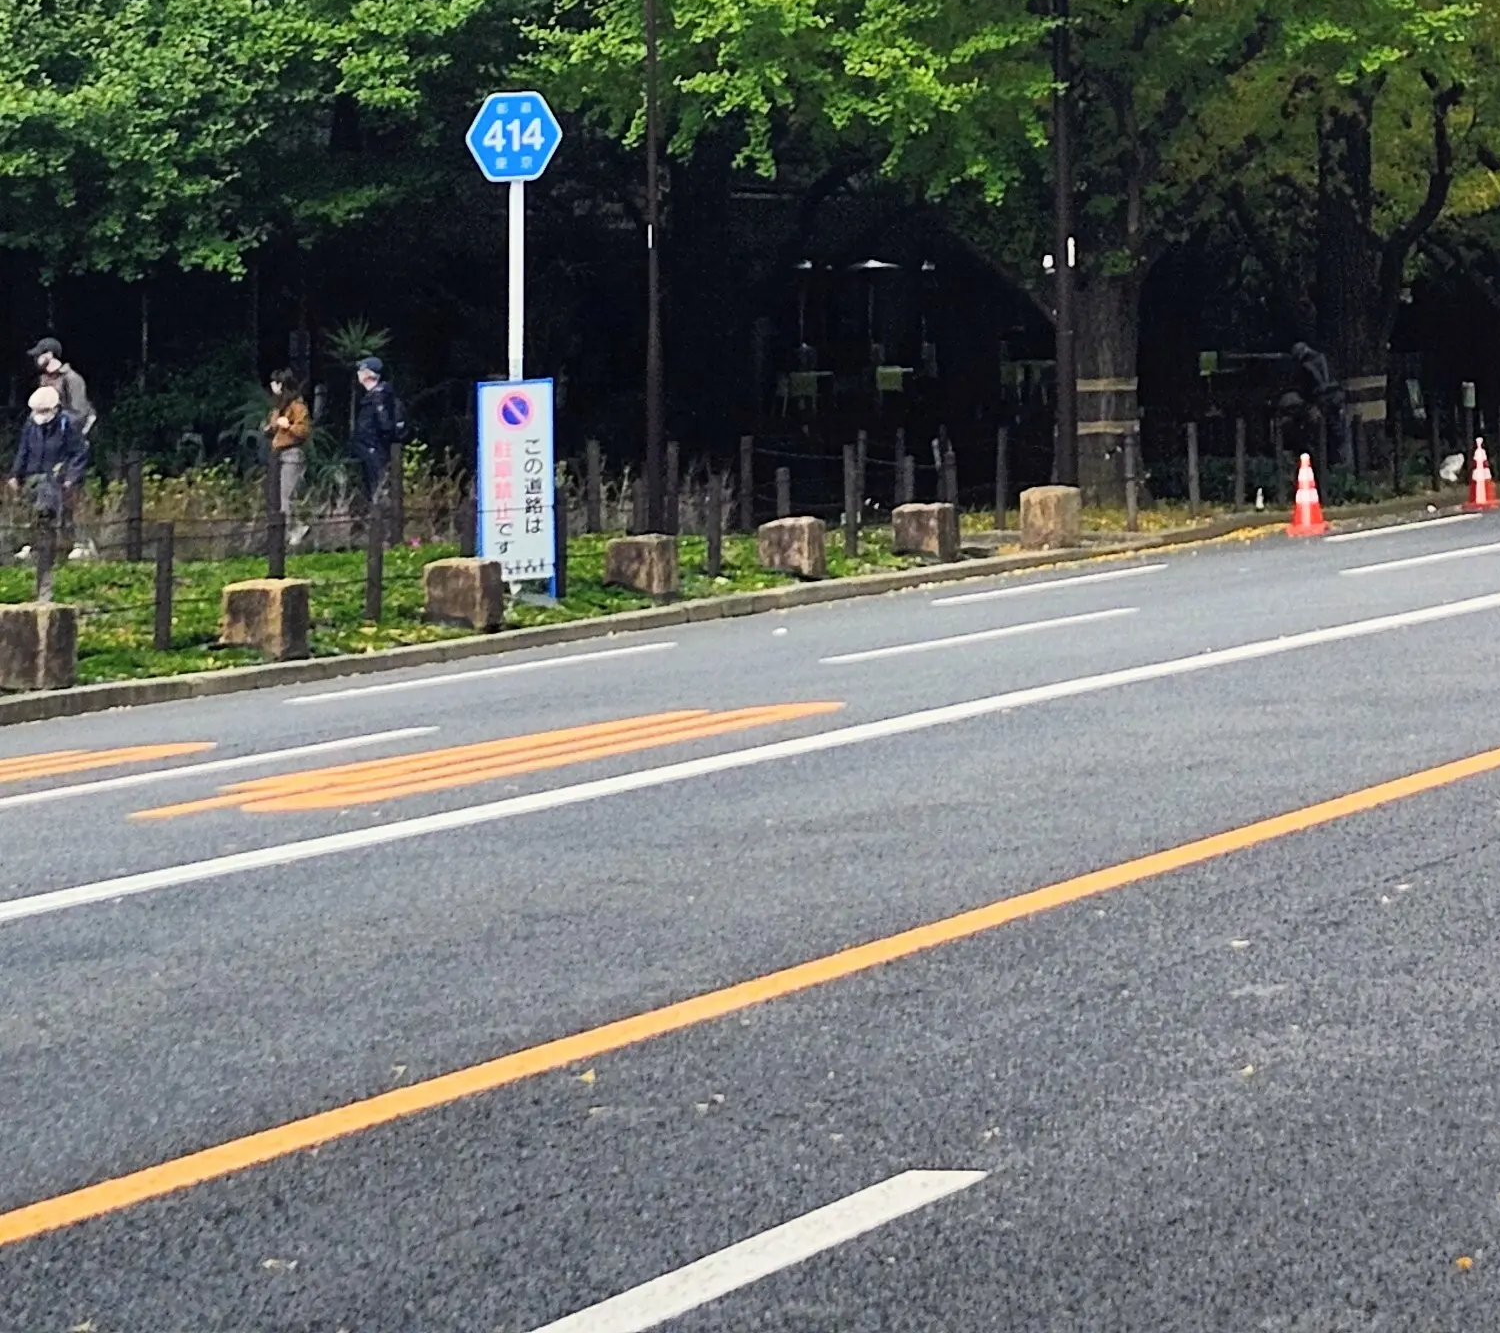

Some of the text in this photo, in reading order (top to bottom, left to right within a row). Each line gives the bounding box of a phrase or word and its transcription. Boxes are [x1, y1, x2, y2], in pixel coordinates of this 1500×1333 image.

[483, 117, 545, 153] 414
[524, 438, 544, 534] この道路は
